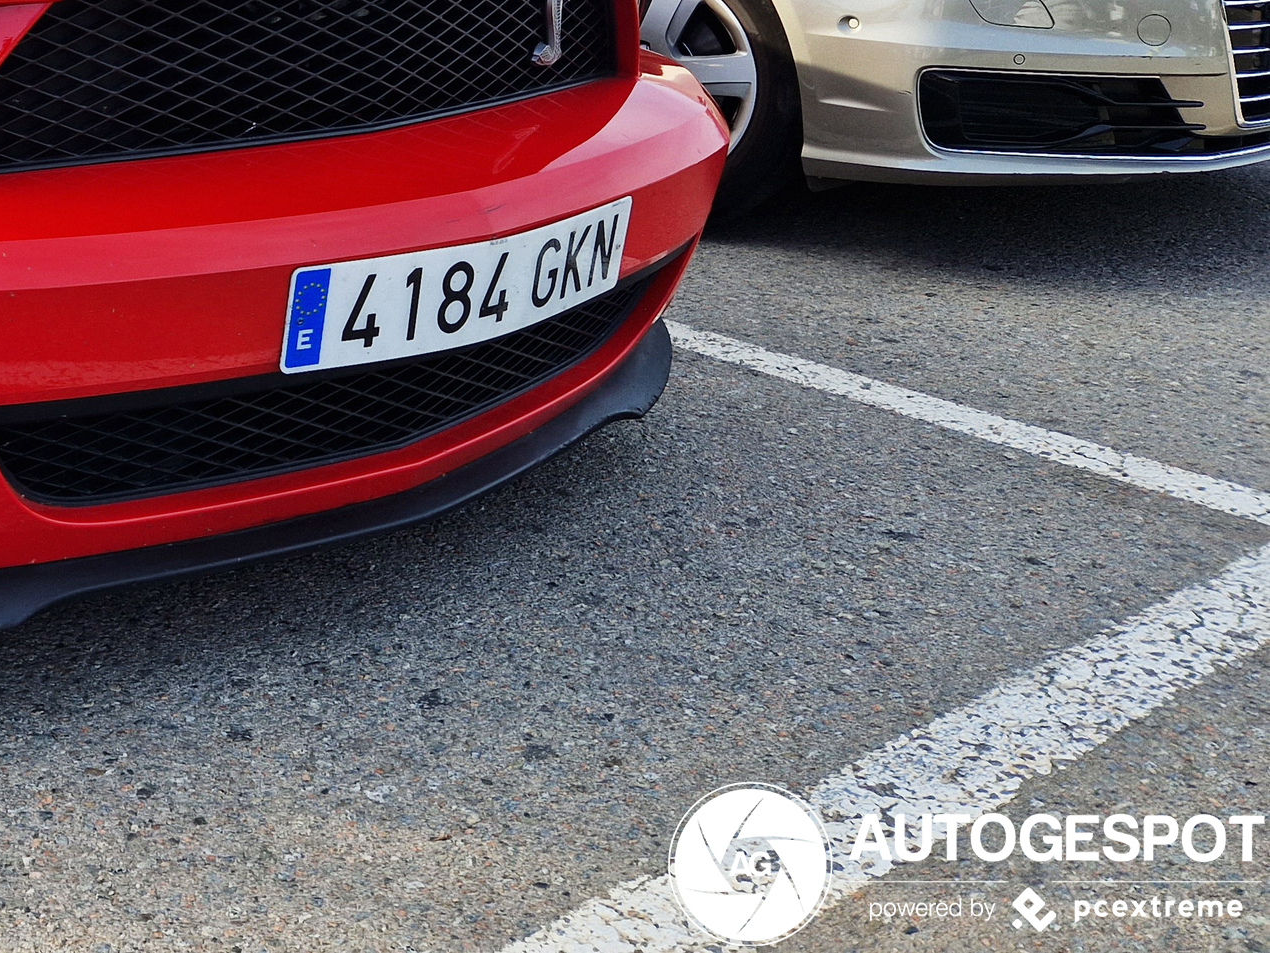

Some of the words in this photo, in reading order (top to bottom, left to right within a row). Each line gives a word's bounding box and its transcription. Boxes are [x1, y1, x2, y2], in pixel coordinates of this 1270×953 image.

[341, 251, 510, 348] 4184
[531, 213, 620, 309] GKN
[296, 328, 314, 350] E
